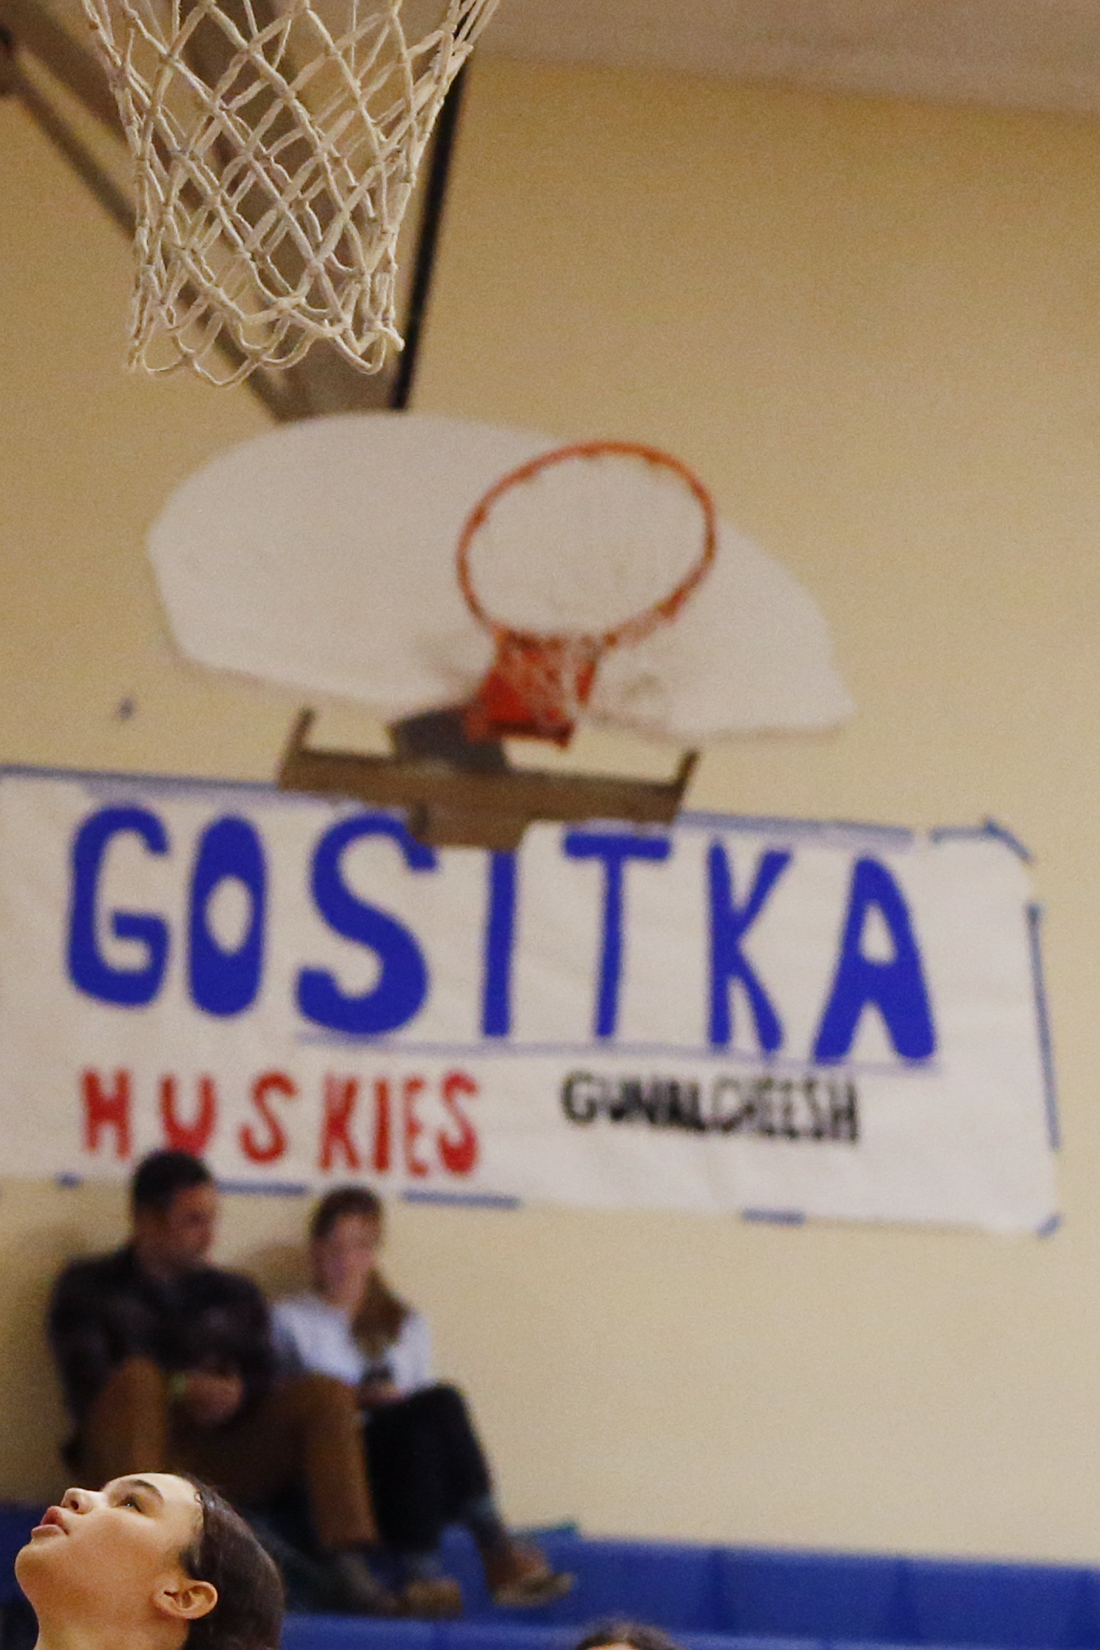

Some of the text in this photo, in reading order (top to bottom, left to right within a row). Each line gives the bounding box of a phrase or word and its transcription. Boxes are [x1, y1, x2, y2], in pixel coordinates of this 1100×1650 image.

[64, 805, 937, 1064] GO SITKA
[79, 1067, 480, 1178] HUSKIES
